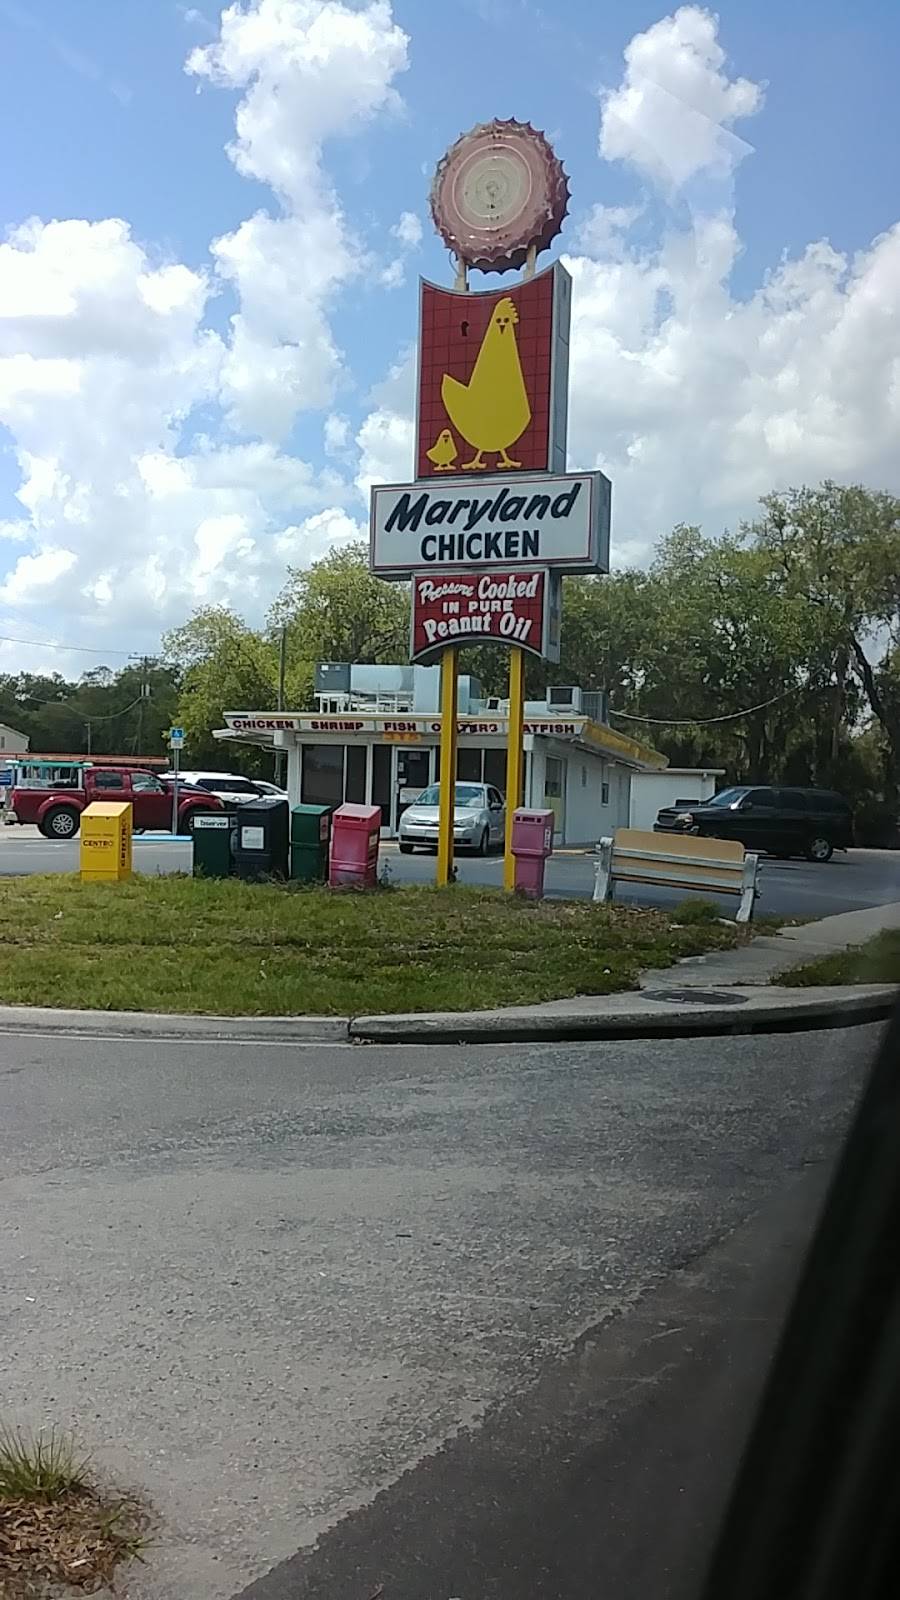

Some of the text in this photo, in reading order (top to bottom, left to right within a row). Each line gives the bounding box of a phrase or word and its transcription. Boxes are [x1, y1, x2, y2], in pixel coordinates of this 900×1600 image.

[384, 482, 582, 533] Maryland
[421, 530, 540, 561] CHICKEN
[418, 573, 540, 605] Pressure Cooked
[442, 599, 514, 614] IN PURE
[423, 612, 533, 642] Peanut Oil
[232, 719, 575, 734] CHICKEN SHRIMP FISH OTERS ATFISH
[82, 839, 113, 847] CENTRO
